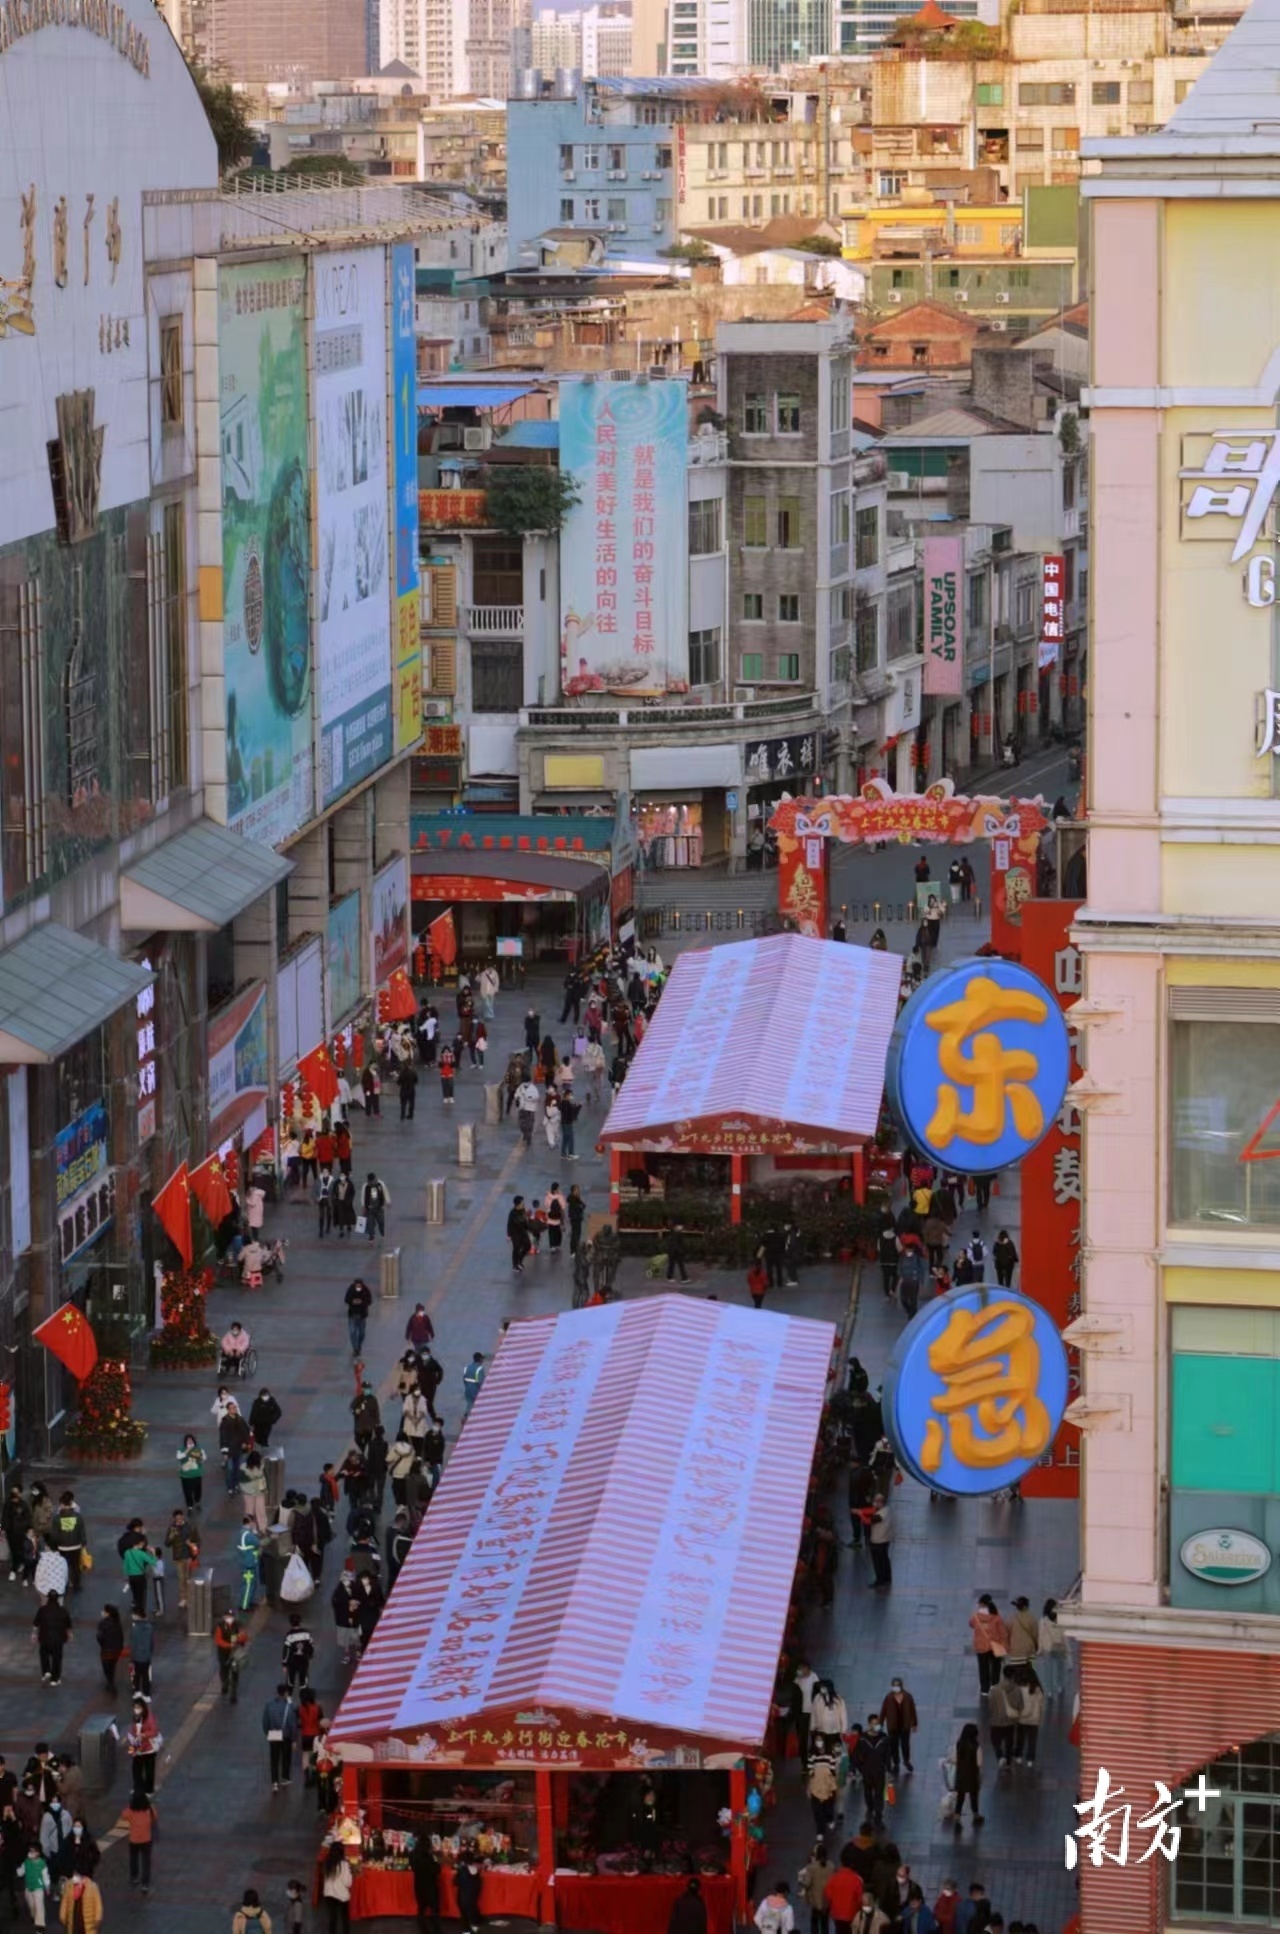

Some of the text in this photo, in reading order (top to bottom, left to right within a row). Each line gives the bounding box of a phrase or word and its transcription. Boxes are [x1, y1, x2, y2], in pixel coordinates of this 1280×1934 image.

[595, 401, 617, 633] 人民对美好生活的向往
[632, 445, 655, 655] 就是我们的奋斗目标
[929, 575, 943, 660] FAMILY
[943, 571, 957, 664] UPSOAR
[1044, 562, 1059, 637] 中国电信
[861, 815, 949, 830] 上下九迎春花市
[925, 978, 1047, 1148] 东
[920, 1300, 1050, 1472] 急
[448, 1730, 628, 1748] 上下九步行街迎春花市
